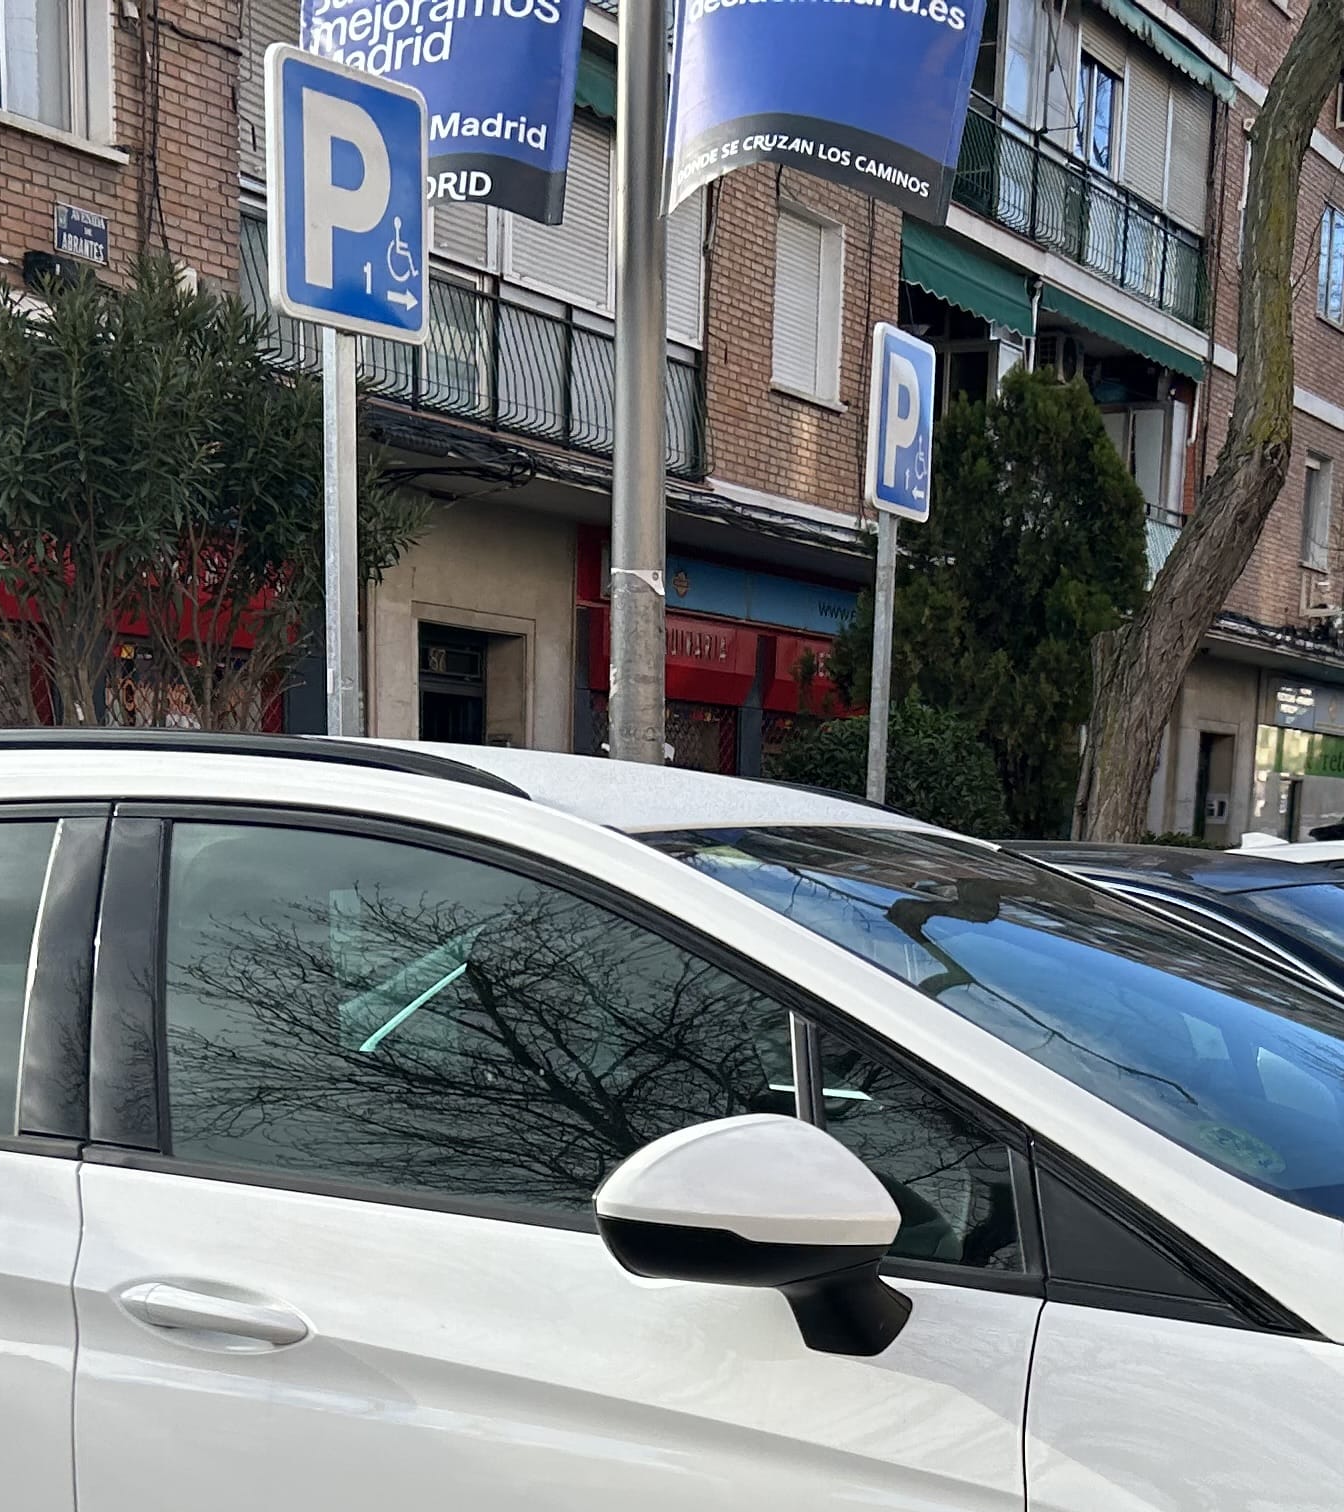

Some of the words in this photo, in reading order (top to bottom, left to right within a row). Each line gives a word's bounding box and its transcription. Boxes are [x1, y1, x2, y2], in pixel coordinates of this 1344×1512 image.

[429, 111, 547, 151] Madrid
[302, 87, 391, 289] P
[677, 148, 718, 185] DONDE
[721, 139, 739, 160] SE
[742, 134, 813, 156] CRUZAN
[818, 143, 851, 167] LOS
[854, 155, 930, 198] CAMINOS
[61, 231, 104, 262] ABRANTES
[363, 262, 372, 295] 1
[883, 351, 921, 489] P
